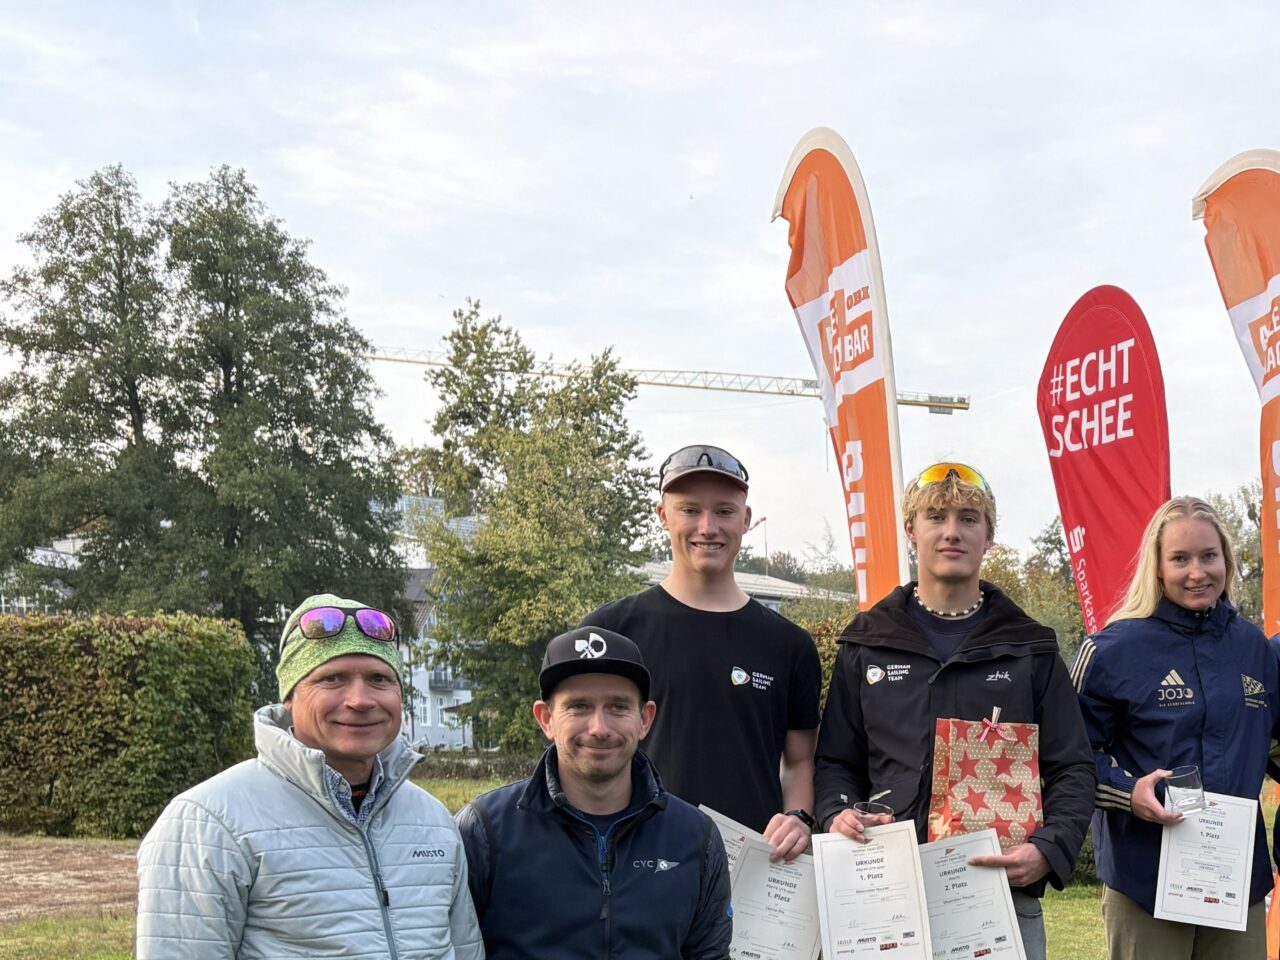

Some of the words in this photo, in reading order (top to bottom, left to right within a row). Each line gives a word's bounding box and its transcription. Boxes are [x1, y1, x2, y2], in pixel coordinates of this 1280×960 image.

[846, 285, 870, 311] OBI
[1050, 338, 1135, 407] #ECHT
[1050, 393, 1135, 458] SCHEE
[986, 670, 1012, 682] zhik
[752, 682, 767, 690] TEAM
[1206, 832, 1220, 840] Platz
[412, 849, 445, 858] MUSTO
[632, 860, 654, 868] CYC
[951, 882, 968, 890] Platz
[774, 893, 791, 903] Platz
